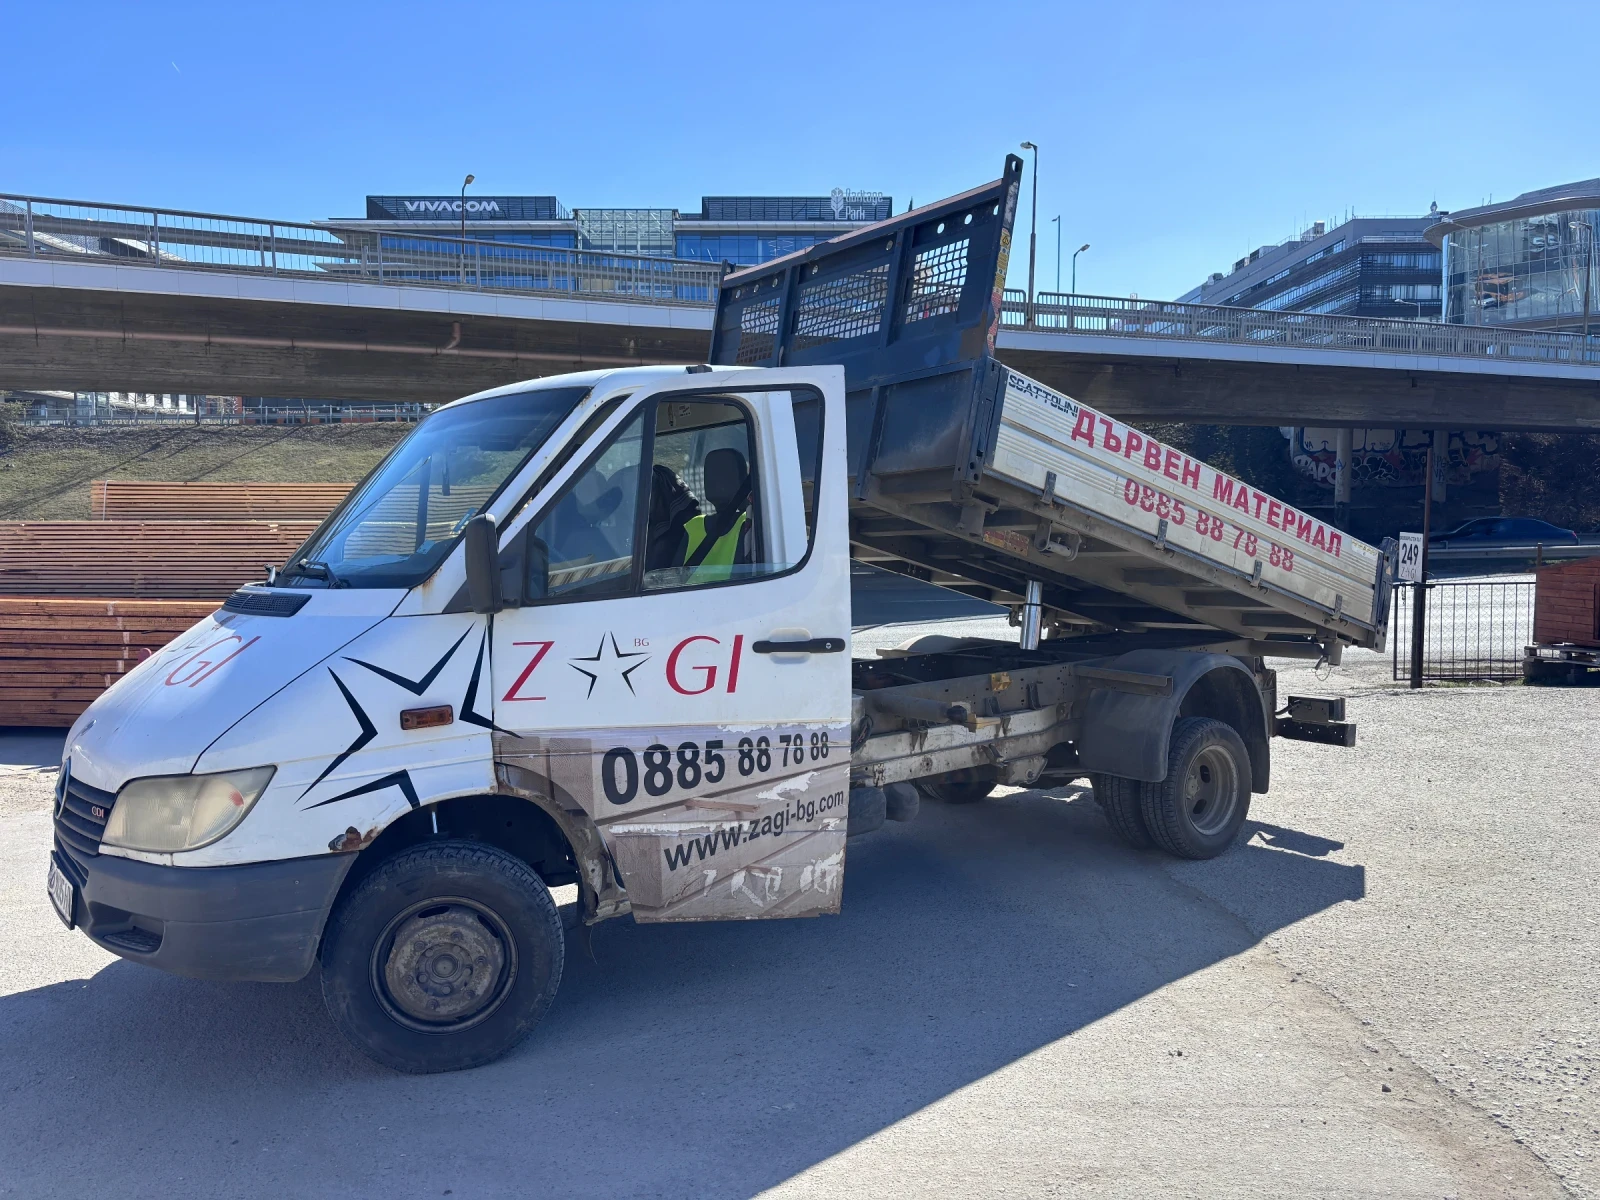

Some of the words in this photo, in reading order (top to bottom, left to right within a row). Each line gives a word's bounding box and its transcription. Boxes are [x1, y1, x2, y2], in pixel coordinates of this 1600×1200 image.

[404, 201, 499, 212] VIVACOM
[846, 206, 865, 220] Park
[1009, 374, 1079, 418] SCATTOLINI
[1071, 408, 1201, 490] ДЪРВЕН
[1213, 473, 1342, 557] МАТЕРИАЛ
[1124, 478, 1186, 525] 0885
[1196, 509, 1224, 541] 88
[1231, 524, 1258, 557] 78
[1269, 542, 1294, 572] 88
[1401, 543, 1418, 565] 249
[165, 636, 262, 687] GI
[634, 638, 650, 647] BG
[601, 740, 725, 805] 0885
[738, 736, 771, 776] 88
[780, 734, 804, 767] 78
[810, 731, 829, 760] 88
[92, 806, 104, 818] CDI
[664, 788, 845, 872] www.zagi-bg.com
